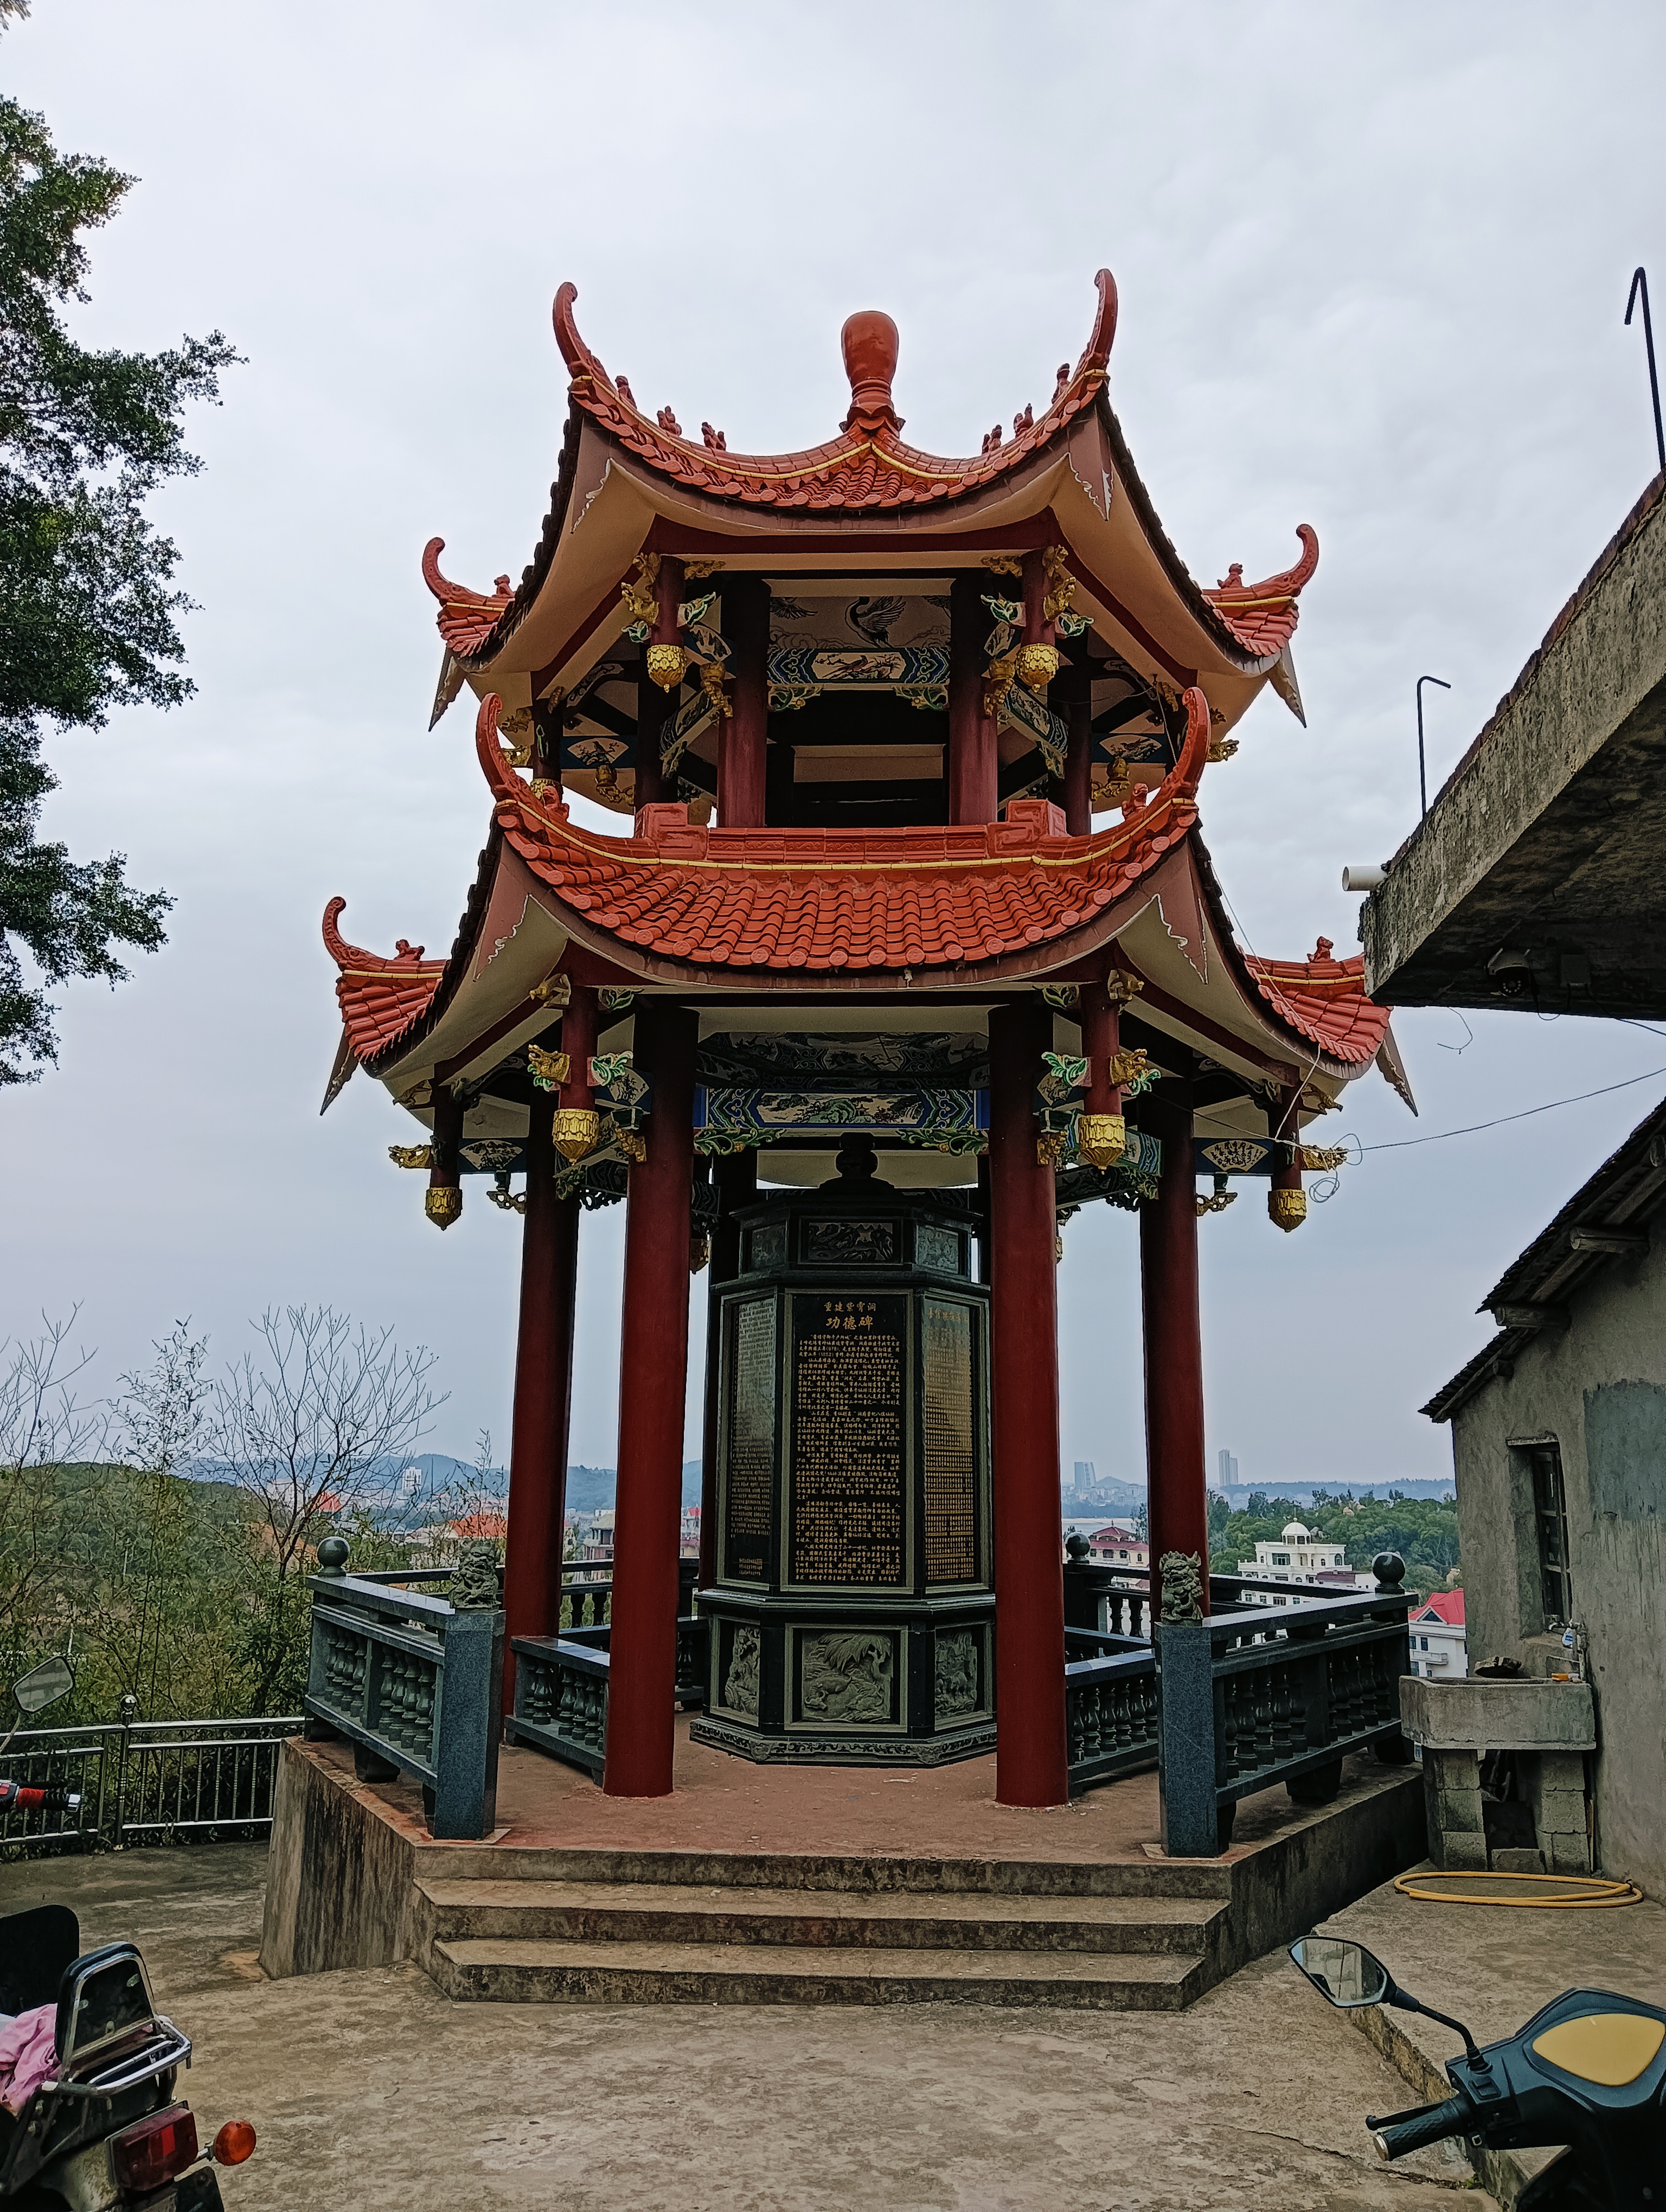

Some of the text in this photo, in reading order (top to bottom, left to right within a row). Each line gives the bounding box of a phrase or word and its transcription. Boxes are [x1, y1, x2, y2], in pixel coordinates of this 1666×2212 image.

[824, 1301, 876, 1313] 重建紫霄洞
[825, 1315, 874, 1331] 功德碑
